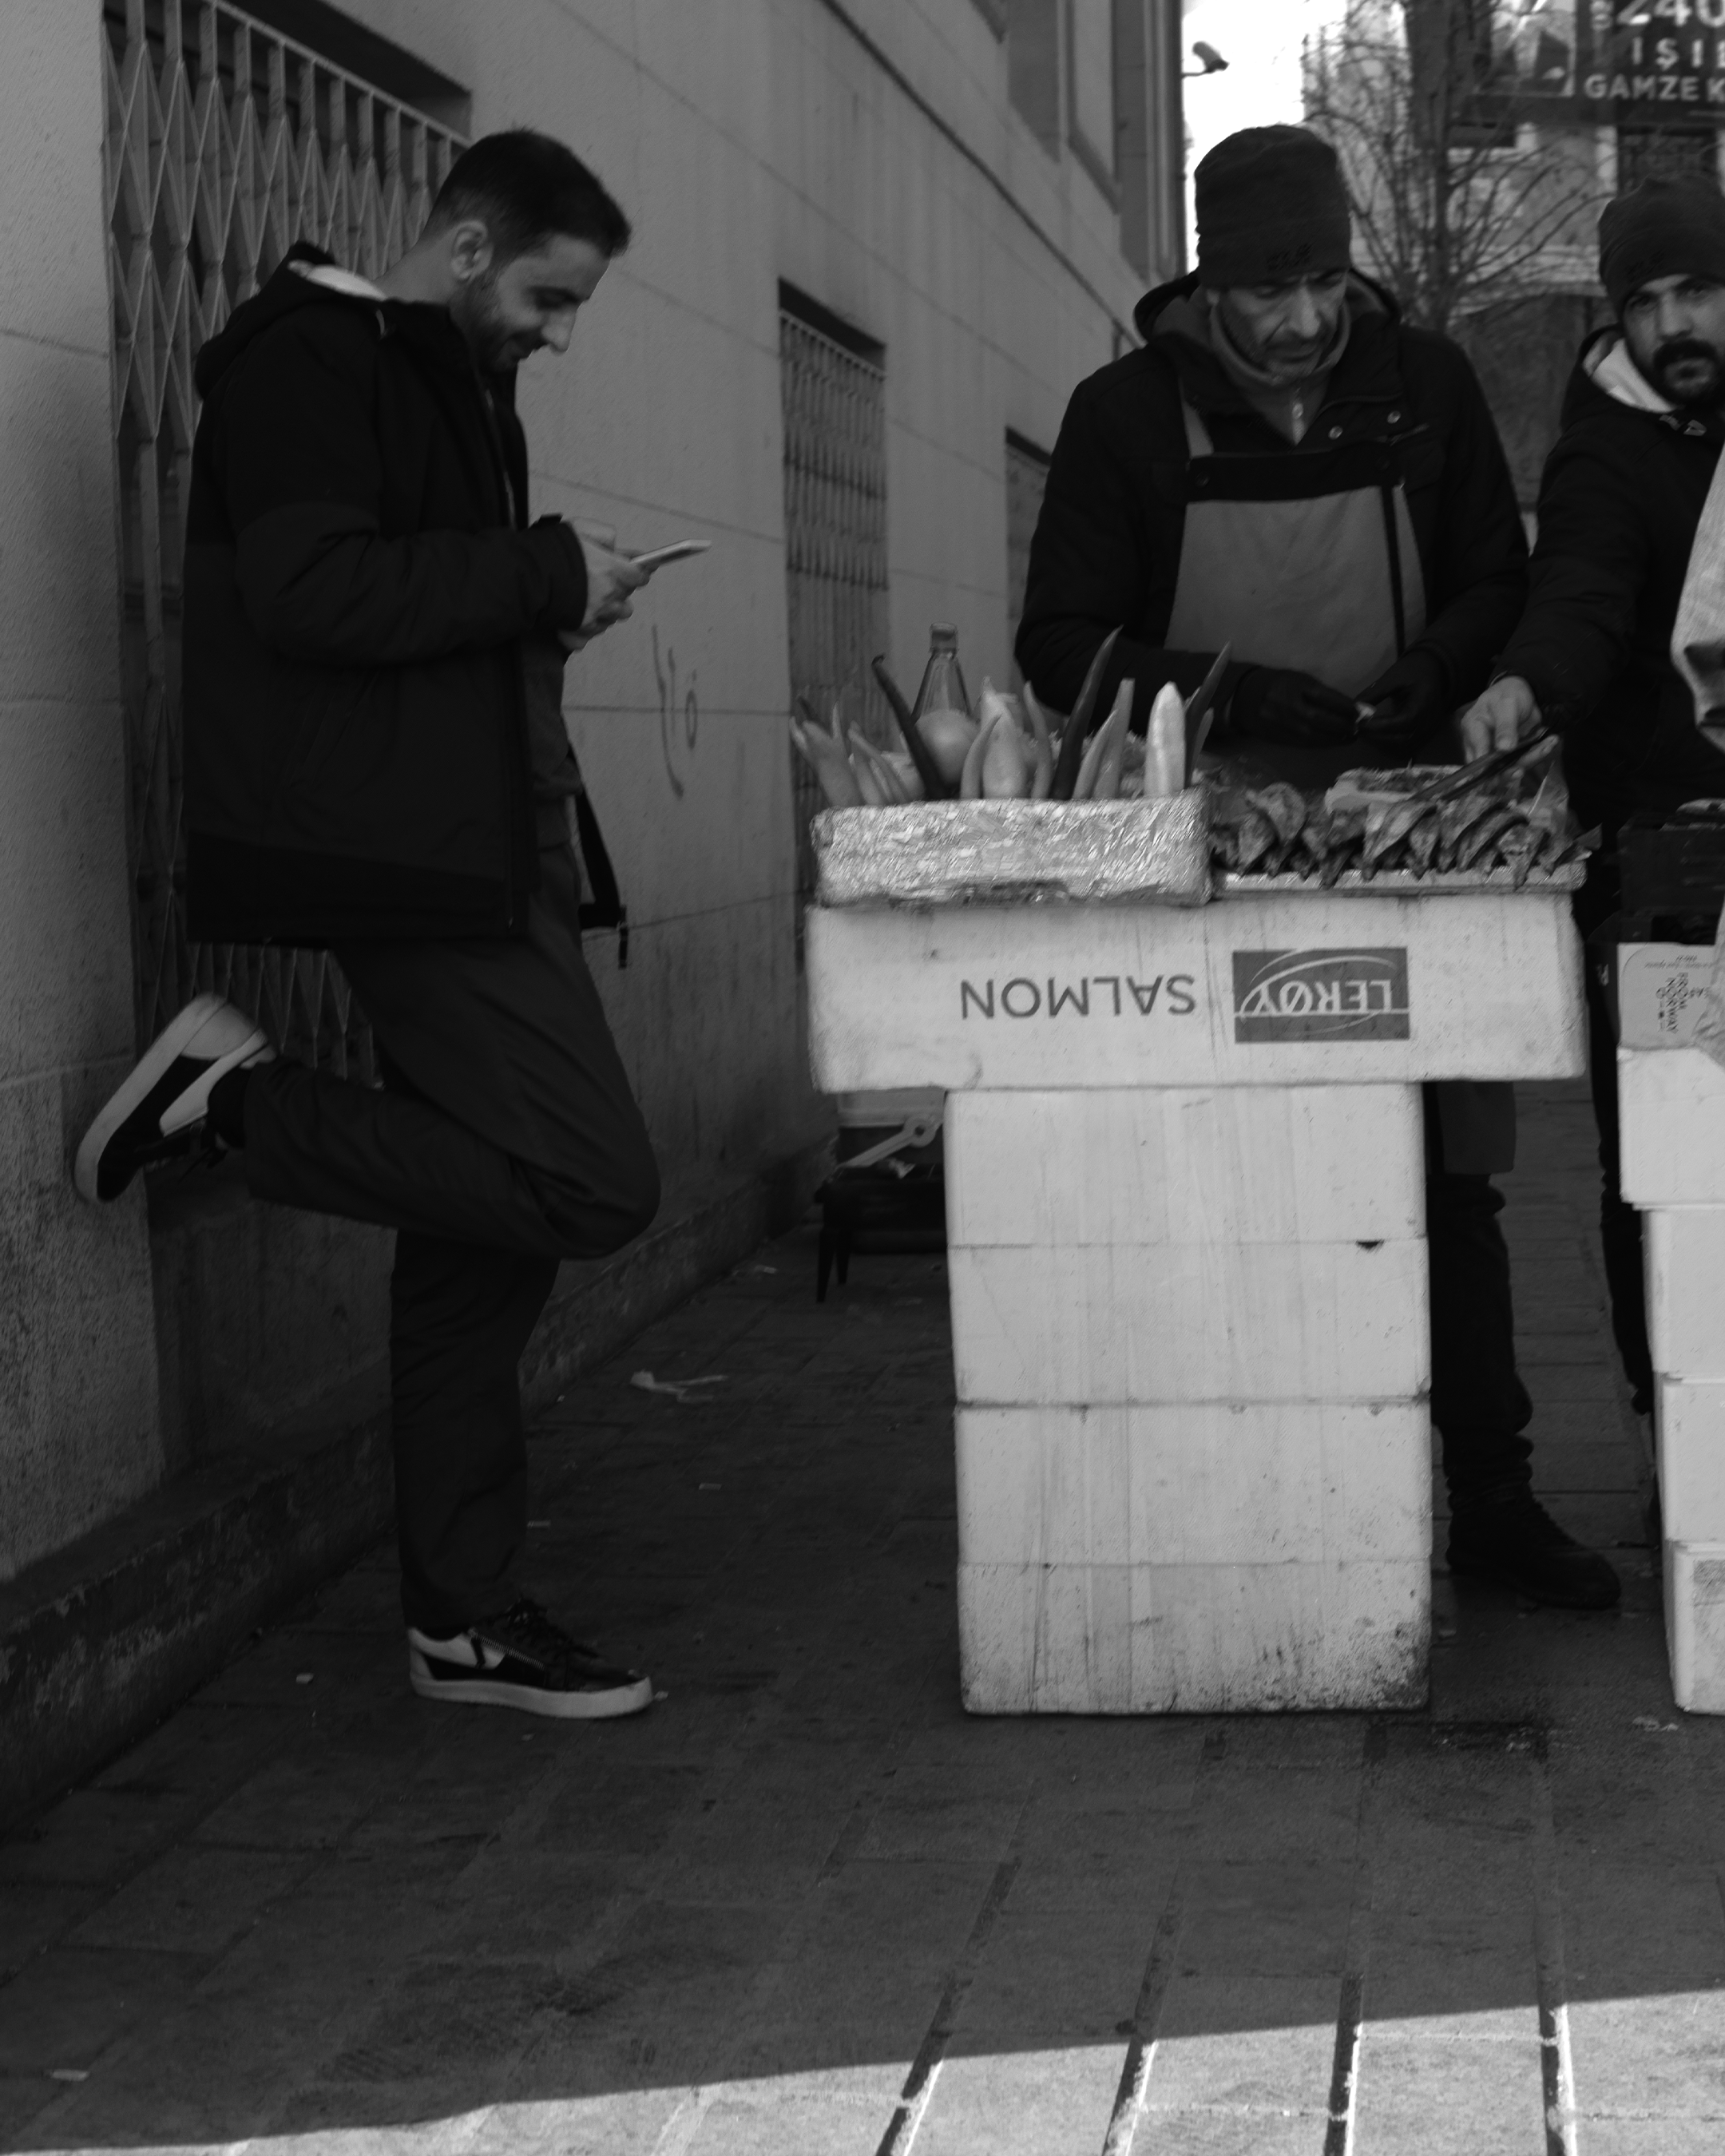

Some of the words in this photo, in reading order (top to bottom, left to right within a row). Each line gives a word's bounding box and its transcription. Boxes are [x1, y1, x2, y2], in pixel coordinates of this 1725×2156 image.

[1584, 73, 1699, 102] GAMZE
[961, 974, 1196, 1020] SALMON
[1251, 979, 1392, 1017] LERØY
